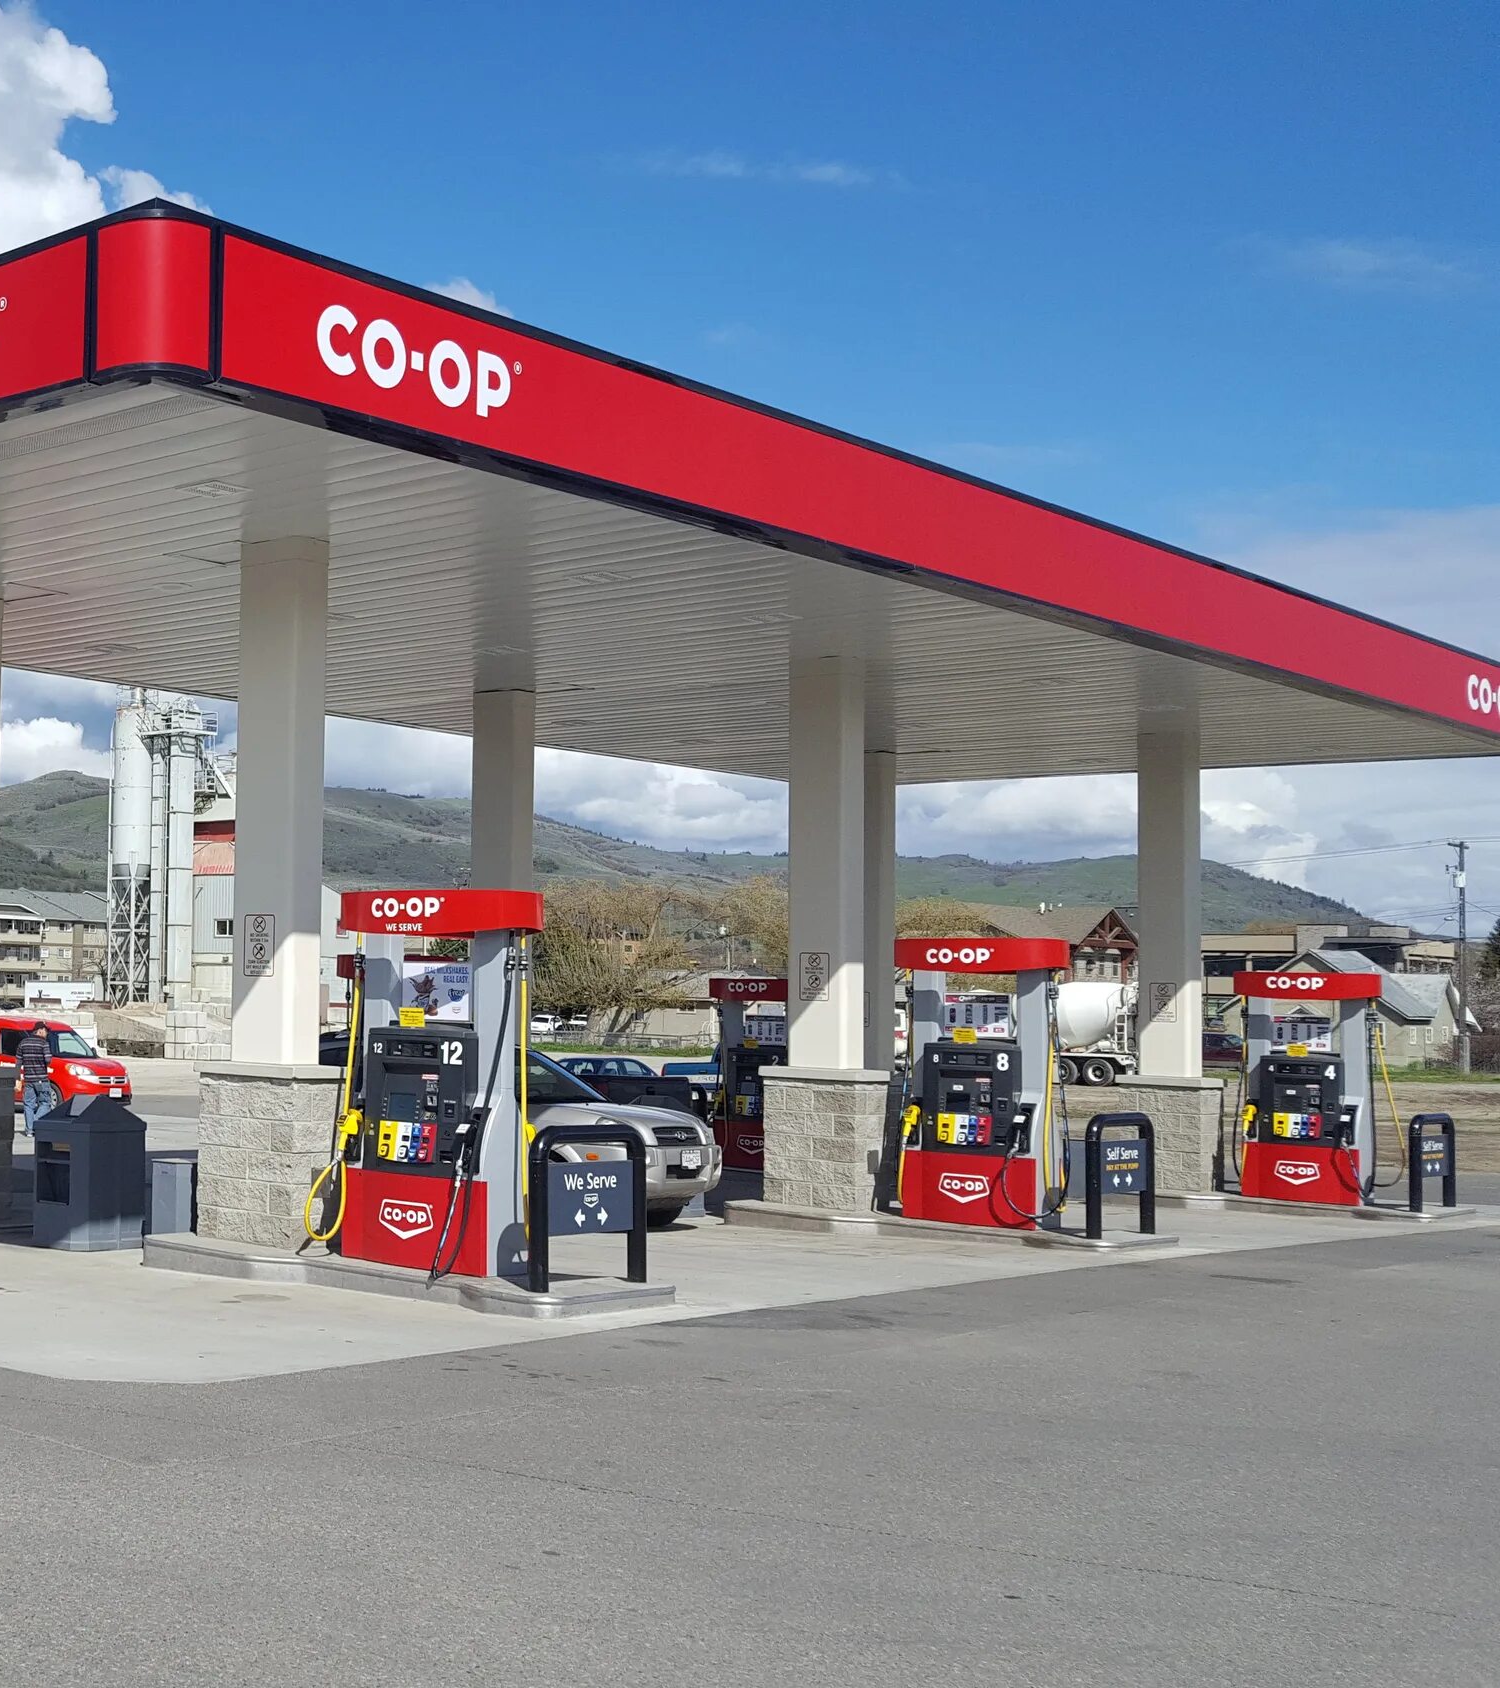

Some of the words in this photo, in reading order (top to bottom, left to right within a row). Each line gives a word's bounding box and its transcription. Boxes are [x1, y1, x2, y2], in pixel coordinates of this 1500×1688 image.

[317, 304, 511, 418] CO-OP
[1467, 674, 1500, 719] CO-
[370, 897, 440, 918] CO-OP
[385, 923, 397, 931] WE
[398, 923, 423, 932] SERVE
[925, 948, 990, 964] CO-OP
[443, 975, 455, 983] REAL
[1266, 976, 1324, 990] CO-OP
[728, 982, 768, 993] CO-OP
[373, 1042, 383, 1054] 12
[440, 1041, 463, 1065] 12
[933, 1054, 939, 1063] 8
[996, 1053, 1009, 1071] 8
[1324, 1065, 1336, 1080] 4
[739, 1138, 764, 1149] CO-OP
[1107, 1146, 1120, 1160] Self
[1120, 1147, 1139, 1159] Serve
[1278, 1165, 1315, 1175] CO-OP
[564, 1173, 583, 1190] We
[586, 1173, 617, 1190] Serve
[943, 1178, 984, 1192] CO-OP
[383, 1207, 427, 1225] CO-OP
